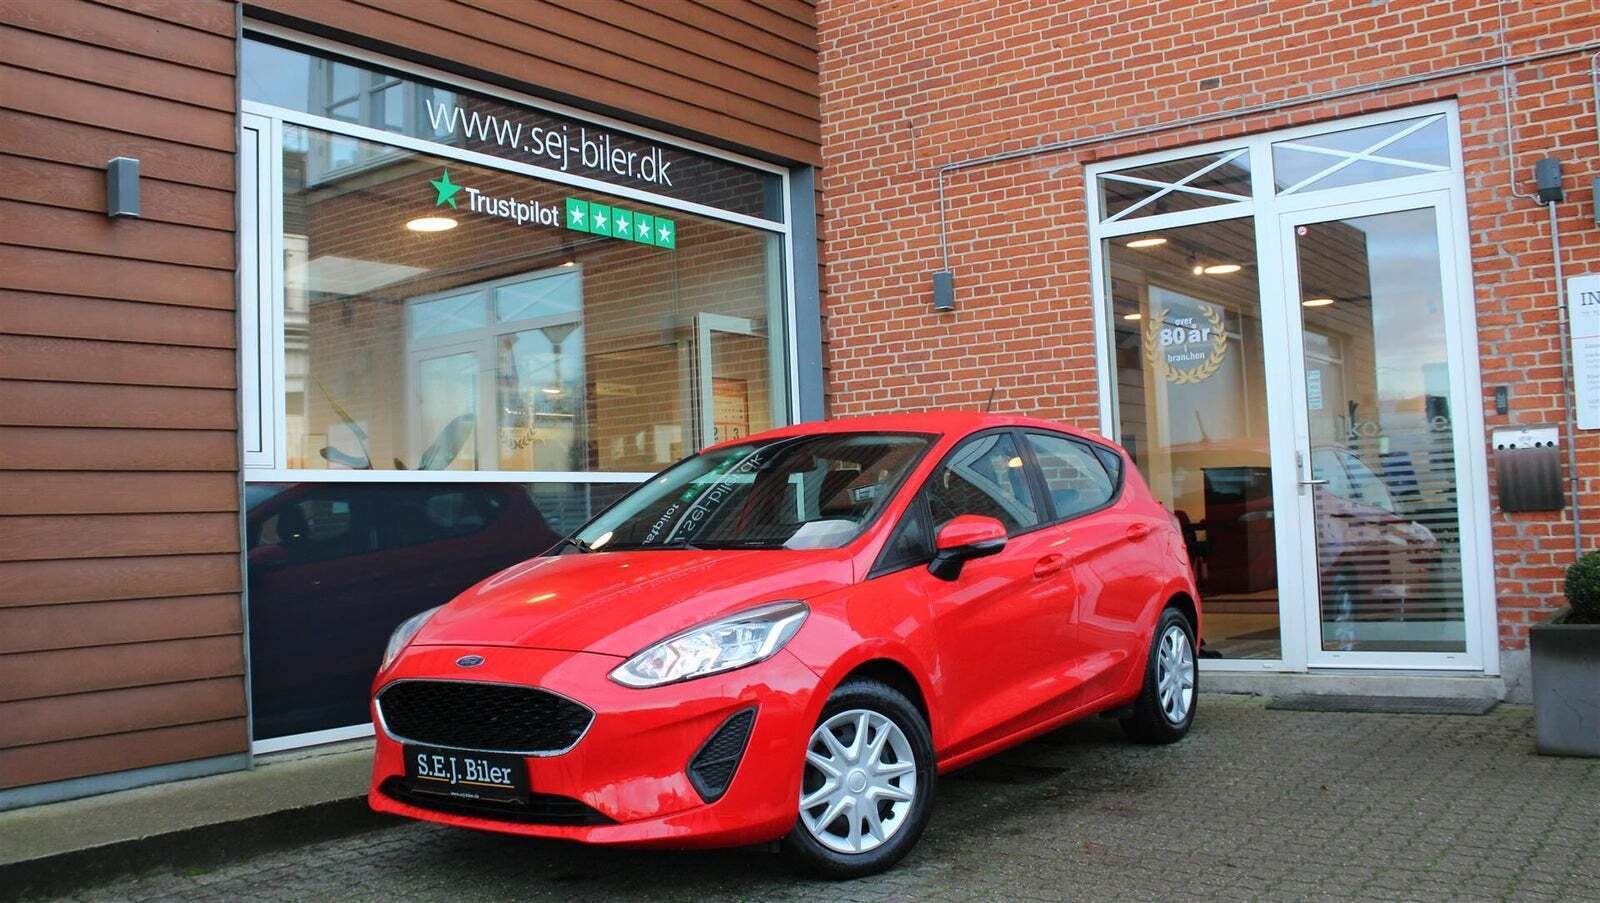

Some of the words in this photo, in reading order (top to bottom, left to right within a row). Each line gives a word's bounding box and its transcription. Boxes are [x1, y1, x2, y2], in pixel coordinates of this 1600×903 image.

[426, 99, 673, 187] www.sej-biler.dk
[465, 187, 560, 227] Trustpilot
[1160, 327, 1185, 346] 80
[1188, 323, 1210, 344] år
[1167, 351, 1205, 362] branchen
[417, 754, 462, 784] S.E.J.
[464, 758, 511, 784] Biler
